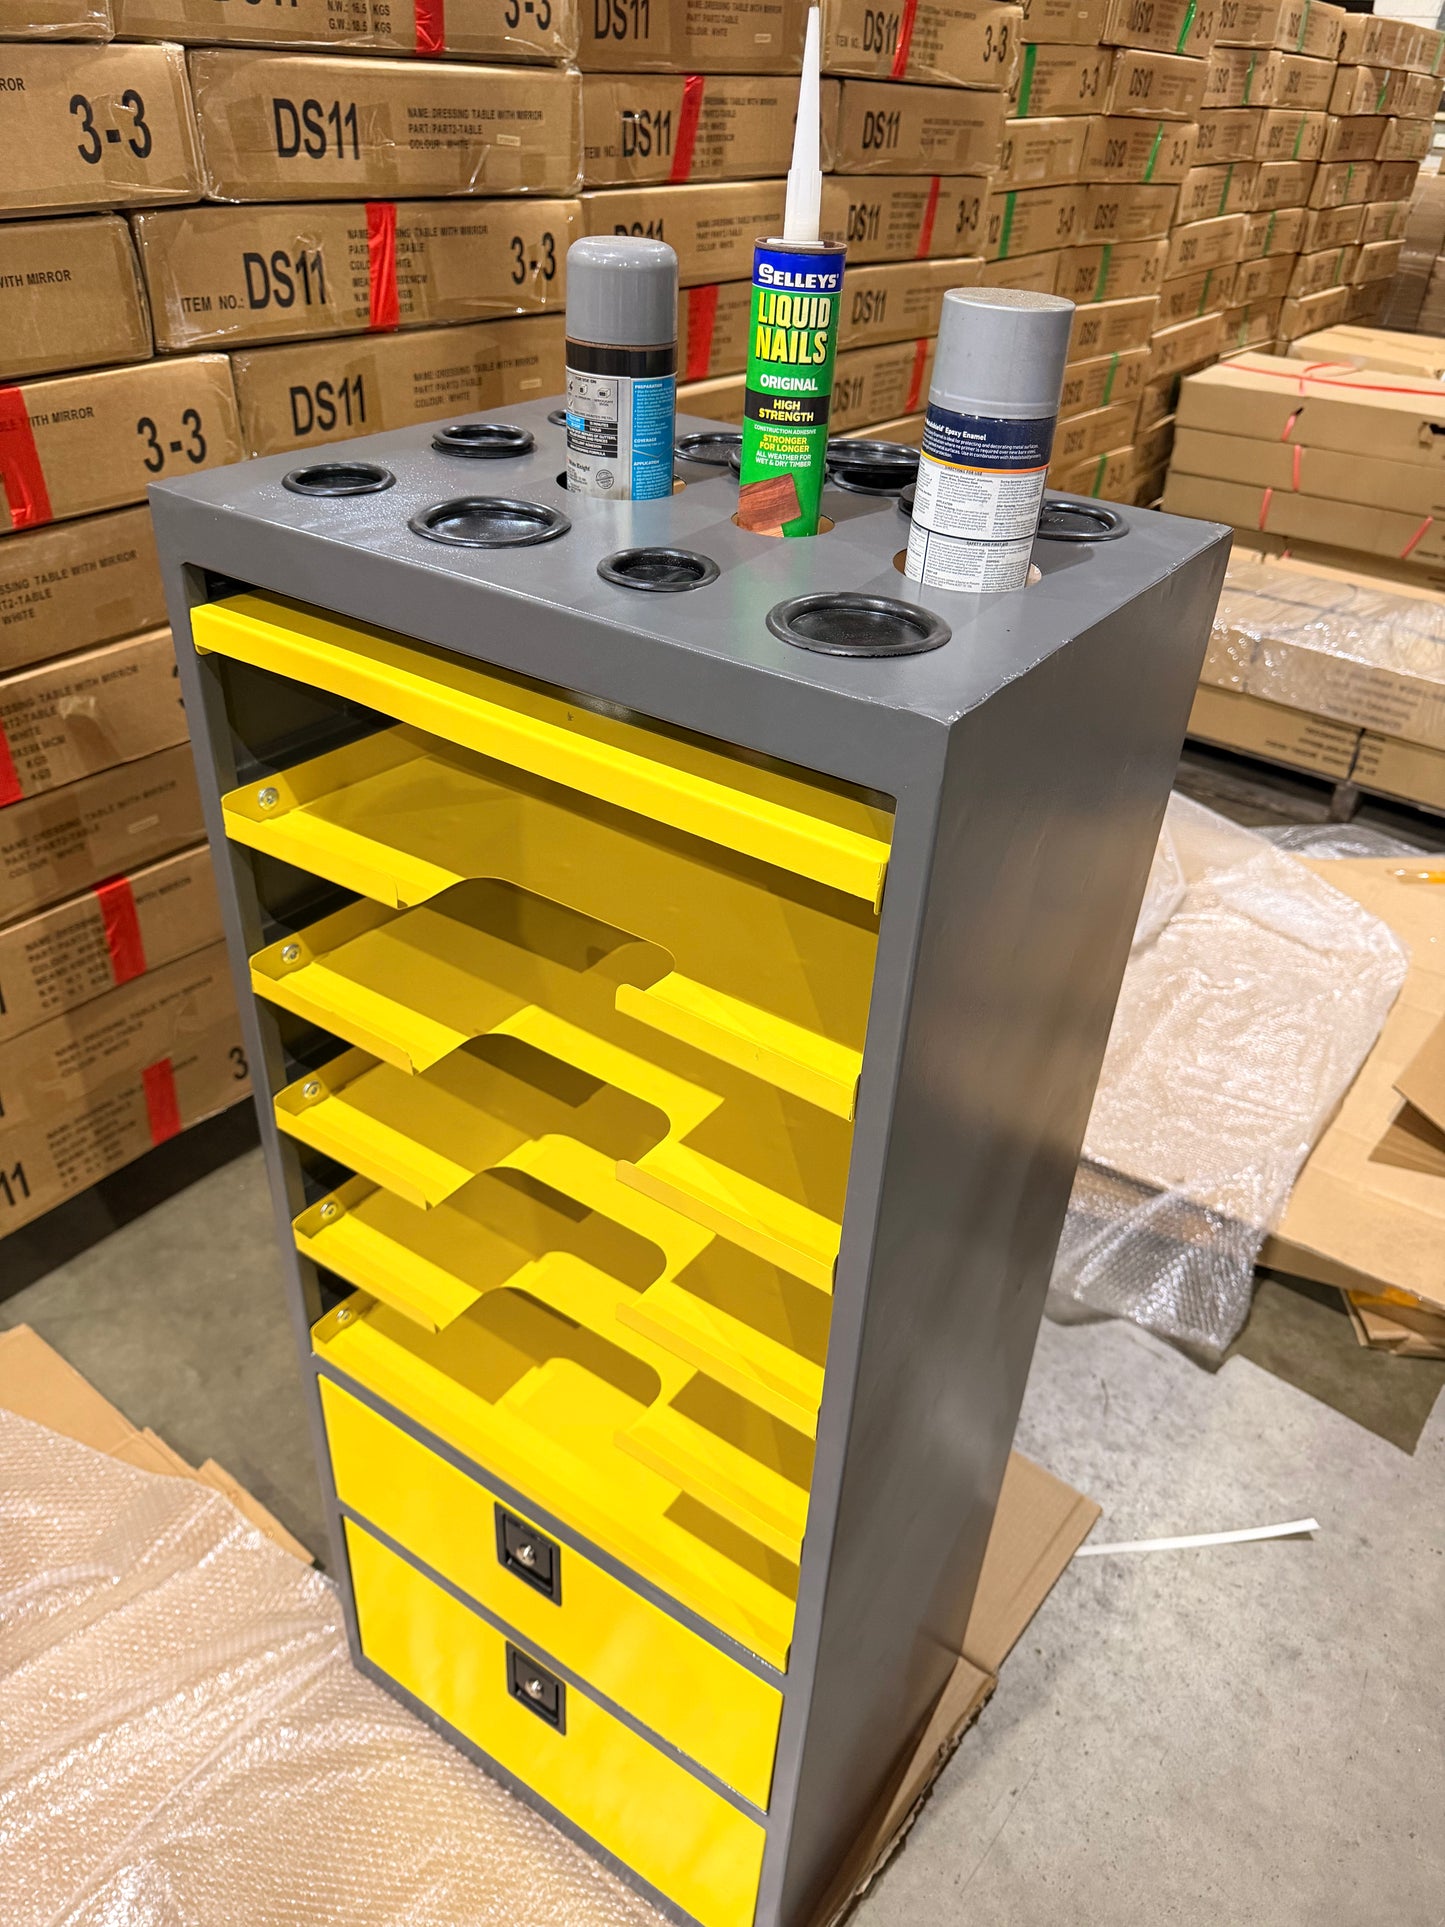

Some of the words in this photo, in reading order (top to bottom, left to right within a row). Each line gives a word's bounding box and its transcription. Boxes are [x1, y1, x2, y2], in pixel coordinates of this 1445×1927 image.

[373, 5, 390, 16] KGS
[375, 22, 391, 33] KGS
[594, 0, 649, 40] DS11
[863, 9, 900, 56] DS11
[983, 25, 1008, 63] 3-3
[70, 89, 152, 164] 3-3
[273, 97, 361, 160] DS11
[622, 109, 671, 157] DS11
[862, 111, 900, 149] DS11
[847, 201, 881, 242] DS11
[956, 198, 980, 234] 3-3
[511, 232, 556, 285] 3-3
[26, 269, 72, 286] MIRROR
[181, 296, 212, 313] ITEM
[243, 250, 327, 310] DS11
[757, 291, 831, 330] LIQUID
[851, 289, 887, 326] DS11
[755, 325, 828, 365] NAILS
[760, 374, 818, 391] ORIGINAL
[52, 406, 95, 423] MIRROR
[289, 374, 367, 436] DS11
[759, 407, 814, 422] STRENGTH
[773, 399, 801, 411] HIGH
[137, 408, 207, 474] 3-3
[754, 424, 793, 435] CONSTRUCTION
[759, 441, 776, 451] FOR
[776, 444, 810, 453] LONGER
[763, 434, 808, 445] STRONGER
[945, 427, 961, 438] Epoxy
[963, 431, 987, 441] Enamel
[755, 456, 769, 465] WET
[790, 460, 812, 468] TIMBER
[756, 450, 767, 458] ALL
[768, 452, 800, 461] WEATHER
[33, 568, 69, 586] TABLE
[71, 561, 97, 576] WITH
